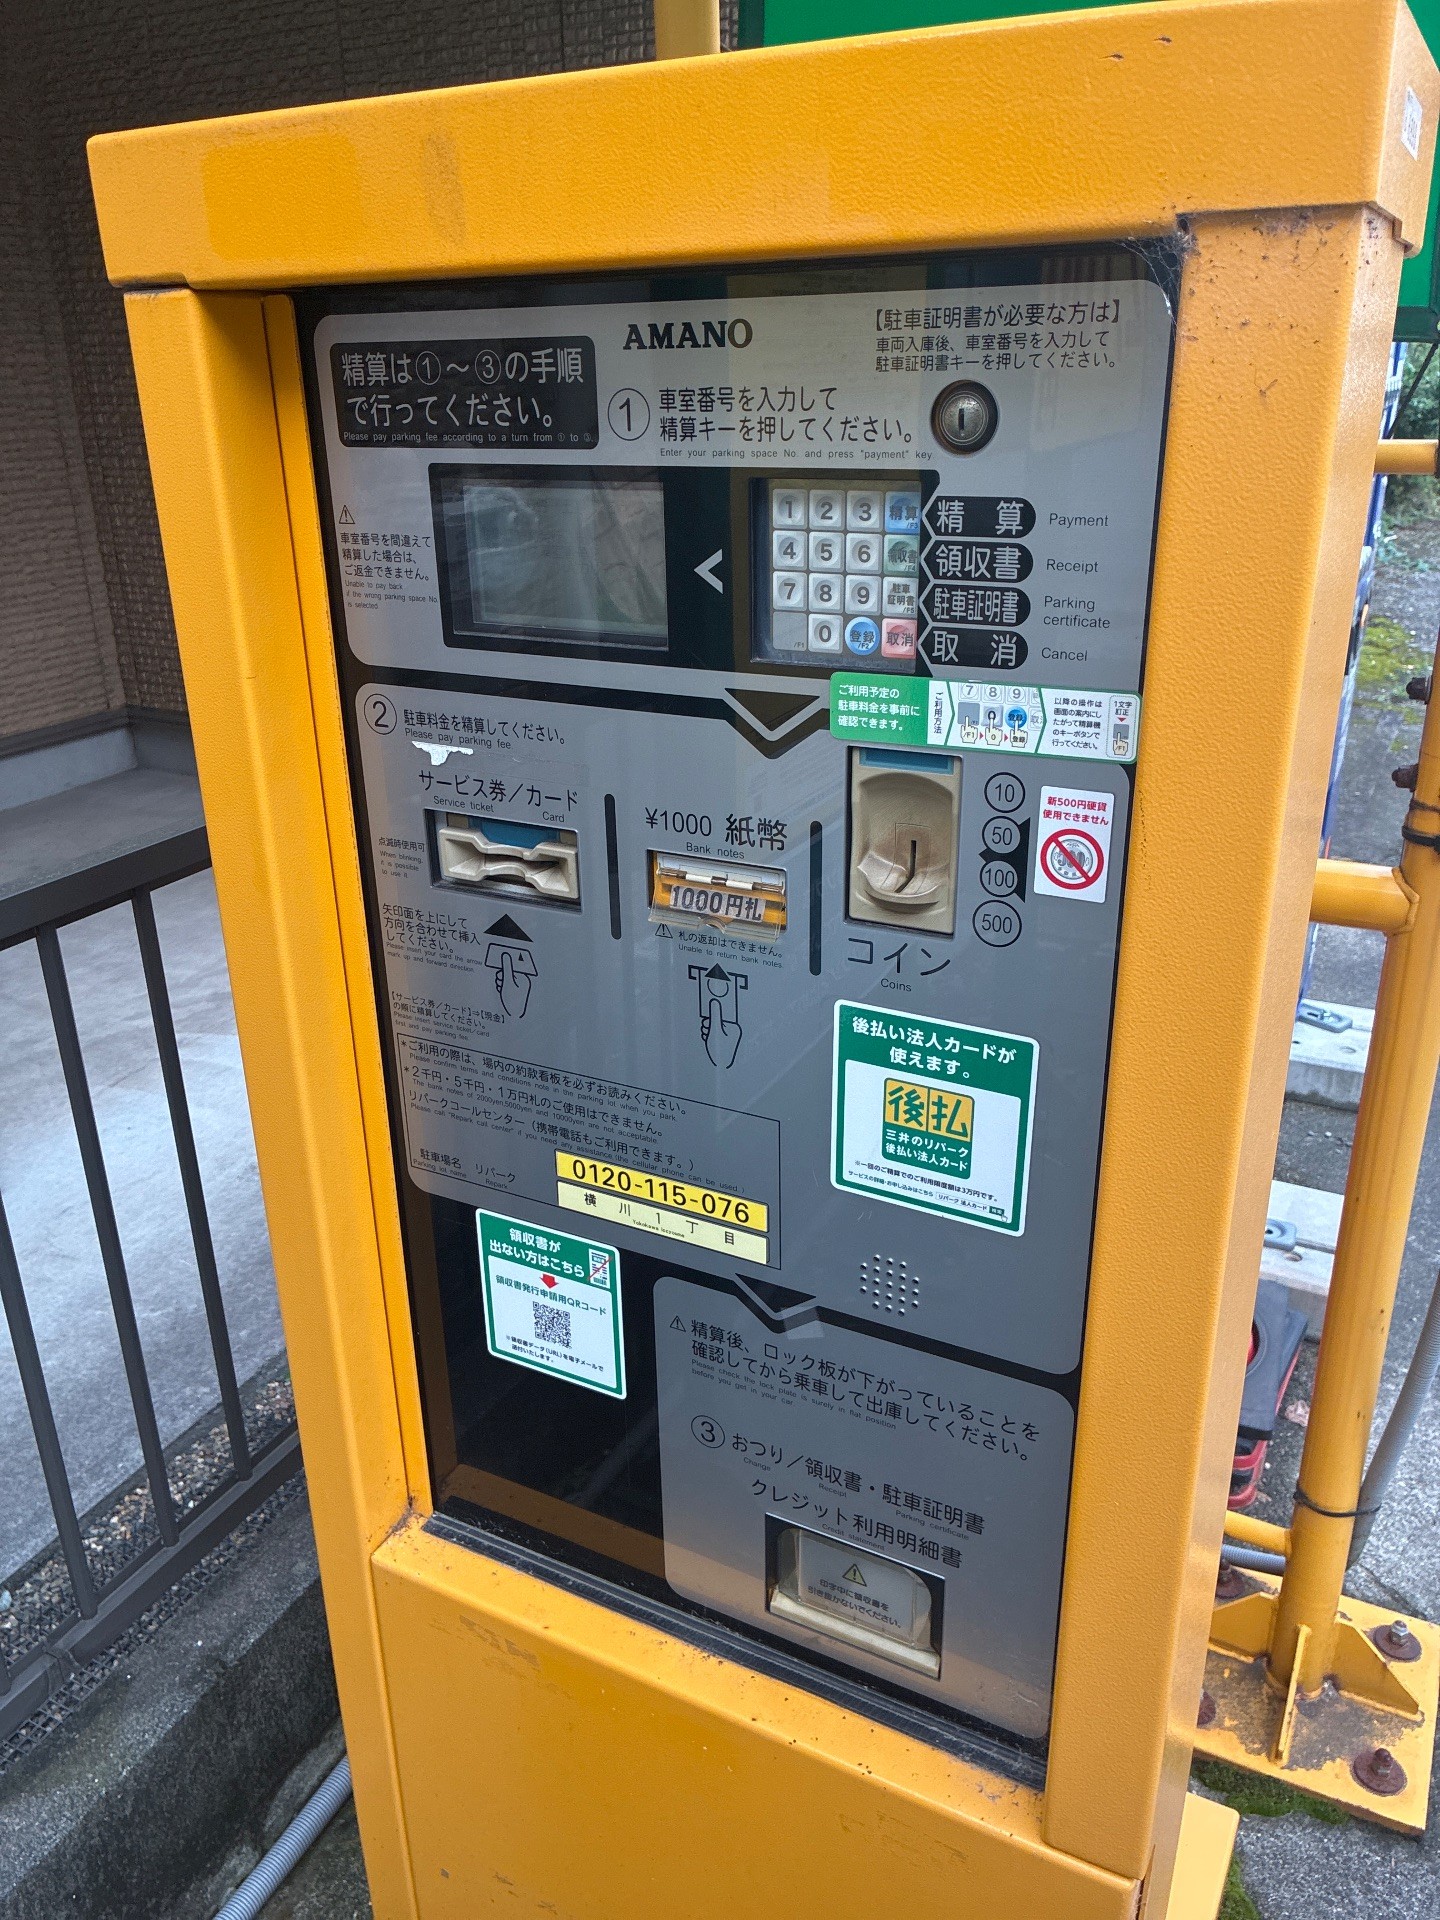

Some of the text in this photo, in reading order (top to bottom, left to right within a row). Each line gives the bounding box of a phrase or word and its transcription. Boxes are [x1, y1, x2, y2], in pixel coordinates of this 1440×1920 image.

[874, 300, 1120, 331] 【駐車証明書が必要な方は】
[622, 319, 753, 350] AMANO
[875, 330, 1108, 353] 車両入庫後、車室番号を入力して
[875, 350, 1116, 372] 駐車証明書キーを押してください。
[659, 386, 838, 413] 車室番号を入力して
[347, 393, 553, 427] で行ってください。
[343, 432, 368, 440] Please
[373, 433, 387, 443] pay
[392, 432, 420, 443] parking
[425, 432, 438, 440] fee
[443, 432, 483, 443] according
[488, 432, 496, 440] to
[511, 432, 528, 440] turn
[533, 431, 552, 440] from
[570, 431, 579, 440] to
[659, 415, 914, 444] 精算キーを押してください。
[660, 448, 682, 457] Enter
[687, 449, 706, 459] your
[712, 447, 745, 459] parking
[750, 449, 778, 459] space
[804, 448, 822, 458] and
[828, 450, 854, 459] press
[786, 500, 793, 518] 1
[820, 501, 833, 520] 2
[859, 502, 872, 521] 3
[1049, 512, 1108, 528] Payment
[340, 532, 431, 547] 車室番号を間違えて
[342, 549, 417, 564] 精算した場合は、
[783, 541, 796, 559] 4
[820, 543, 833, 561] 5
[858, 544, 870, 563] 6
[935, 545, 1021, 581] 領収書
[1046, 558, 1099, 575] Receipt
[345, 565, 430, 581] ご返金できません。
[385, 594, 405, 602] parking
[784, 582, 796, 599] 7
[820, 584, 832, 602] 8
[857, 586, 870, 604] 9
[892, 583, 910, 594] 駐車
[888, 594, 915, 606] 証明書
[933, 588, 1019, 625] 駐車証明書
[1044, 596, 1096, 613] Parking
[1043, 614, 1110, 630] certificate
[819, 624, 831, 643] 0
[850, 630, 875, 643] 登録
[886, 632, 914, 647] 取消
[1041, 647, 1087, 663] Cancel
[838, 683, 900, 699] ご利用予定の
[966, 685, 974, 696] 7
[989, 686, 997, 697] 8
[1013, 688, 1020, 699] 9
[838, 700, 920, 716] 駐車料金を事前に
[933, 692, 943, 735] ご利用方法
[404, 709, 565, 745] 駐車料金を精算してください。
[838, 715, 904, 731] 確認できます。
[405, 727, 492, 748] Please pay parking
[1052, 738, 1098, 750] 行ってください。
[1053, 729, 1101, 740] のキーボタンで
[419, 770, 578, 811] サービス券／カード
[994, 783, 1015, 803] 10
[434, 795, 494, 812] Service ticket
[1047, 796, 1107, 812] 新500円硬貨
[542, 811, 565, 822] Card
[1043, 809, 1109, 825] 使用できません
[645, 806, 787, 851] ¥1000 紙幣
[991, 827, 1013, 846] 50
[686, 842, 745, 860] Bank notes
[984, 869, 1015, 889] 100
[672, 885, 762, 922] 1000円札
[382, 903, 468, 929] 矢印面を上にして
[981, 913, 1013, 934] 500
[384, 917, 481, 946] 方向を合わせて挿入
[386, 930, 454, 954] してください。
[679, 930, 783, 959] 札の返却はできません。
[678, 944, 759, 964] Unable return bank
[848, 937, 951, 976] コイン
[881, 978, 912, 992] Coins
[393, 1002, 486, 1029] の順に精算してください。
[852, 1016, 1017, 1064] 後払い法人カードが
[890, 1046, 970, 1079] 使えます。
[578, 1092, 603, 1105] parking
[887, 1085, 969, 1138] 後払
[885, 1129, 969, 1156] 三井のリパーク
[420, 1149, 516, 1184] 駐車場名 リパーク
[885, 1143, 967, 1171] 後払い法人カード
[573, 1159, 749, 1224] 0120-115-076
[509, 1228, 561, 1253] 領収書が
[489, 1239, 585, 1278] 出ない方はこちら
[496, 1274, 606, 1315] 領収書発行申請用QRコード
[691, 1319, 1040, 1441] 精算後、ロック板が下がっていることを
[691, 1339, 1028, 1461] 確認してから乗車して出庫してください。
[732, 1433, 985, 1536] おつり／領収書・駐車証明書
[743, 1456, 969, 1541] Change Receipt Parking certificate
[751, 1478, 963, 1569] クレジット利用明細書
